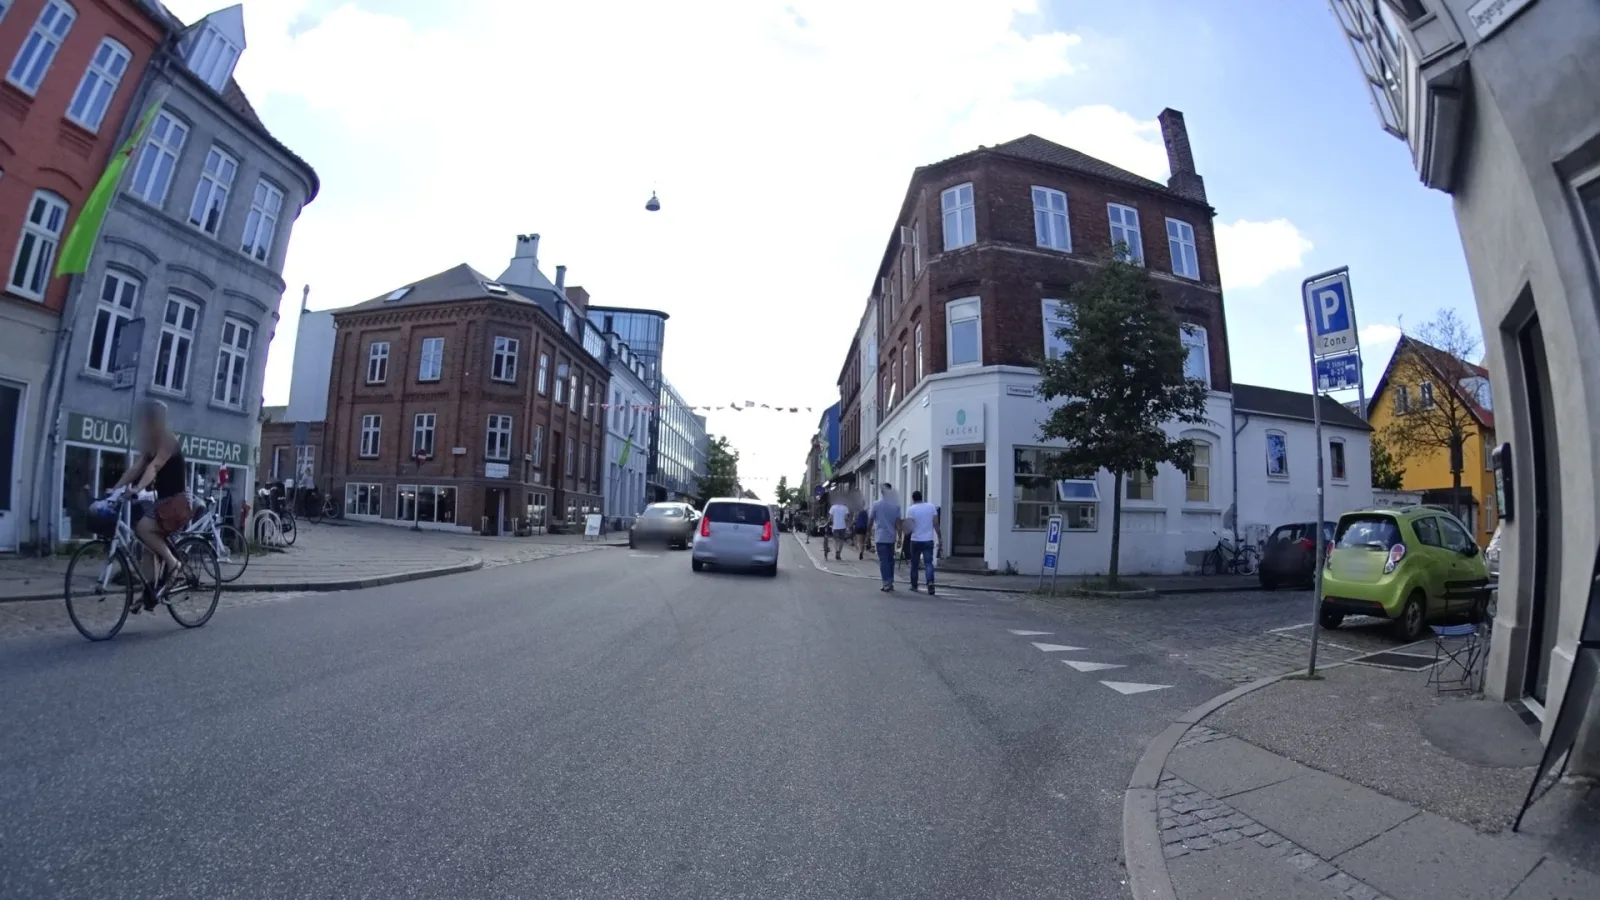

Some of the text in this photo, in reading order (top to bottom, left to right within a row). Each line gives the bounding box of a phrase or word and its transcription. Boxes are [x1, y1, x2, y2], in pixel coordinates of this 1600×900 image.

[1319, 290, 1340, 330] P
[1323, 336, 1347, 348] Zone
[1050, 523, 1058, 542] P
